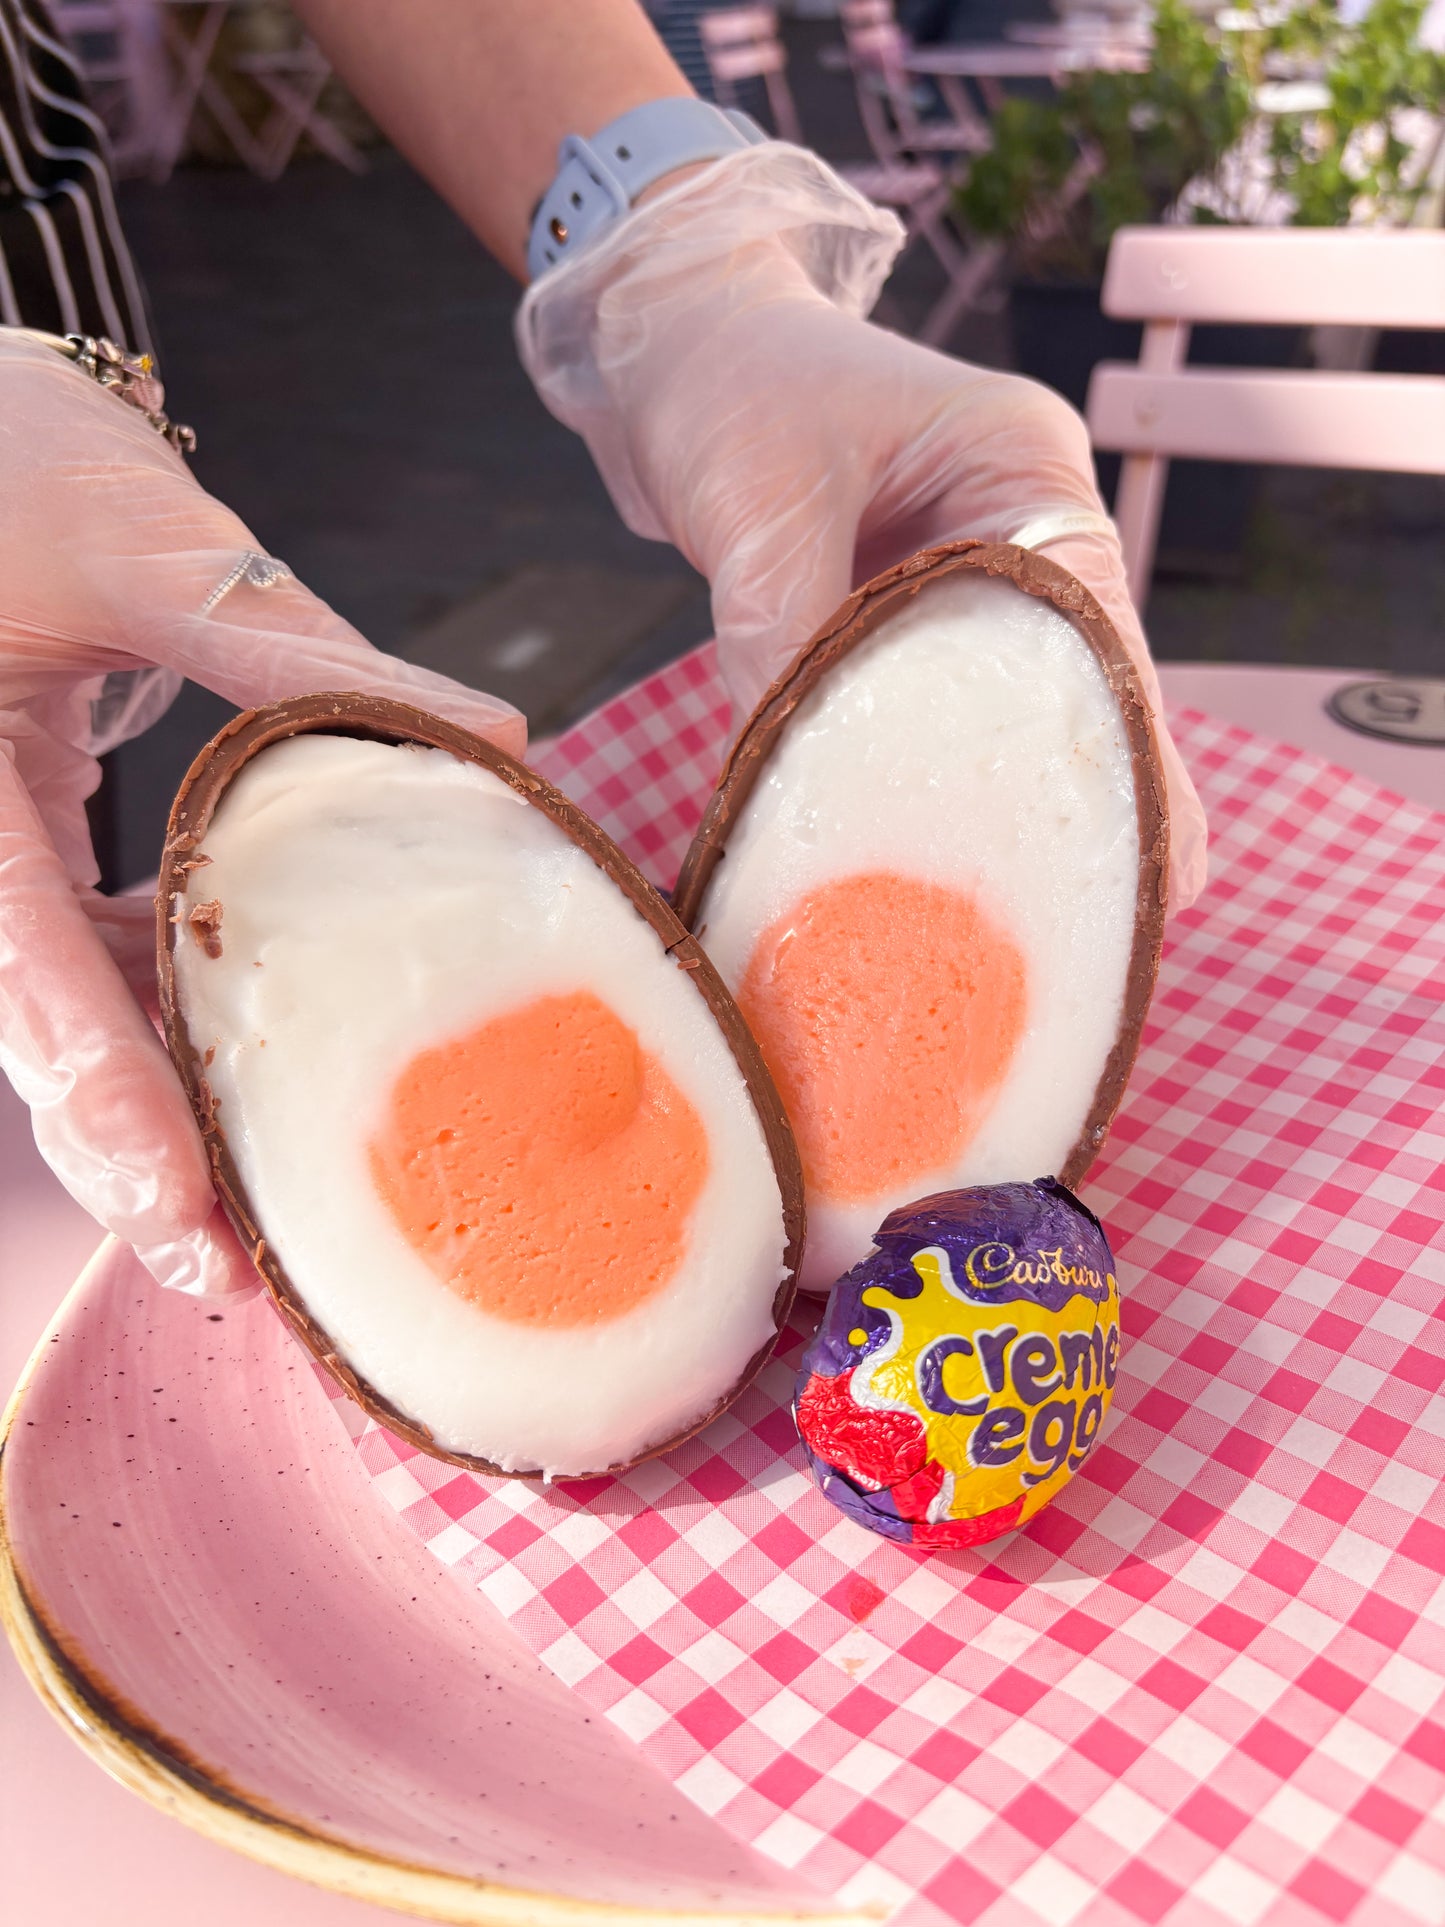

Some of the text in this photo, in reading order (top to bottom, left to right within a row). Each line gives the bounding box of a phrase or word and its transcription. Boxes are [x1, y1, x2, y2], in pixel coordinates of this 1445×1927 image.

[965, 1241, 1103, 1289] Cadbur
[918, 1324, 1118, 1415] creme
[968, 1393, 1104, 1485] egg
